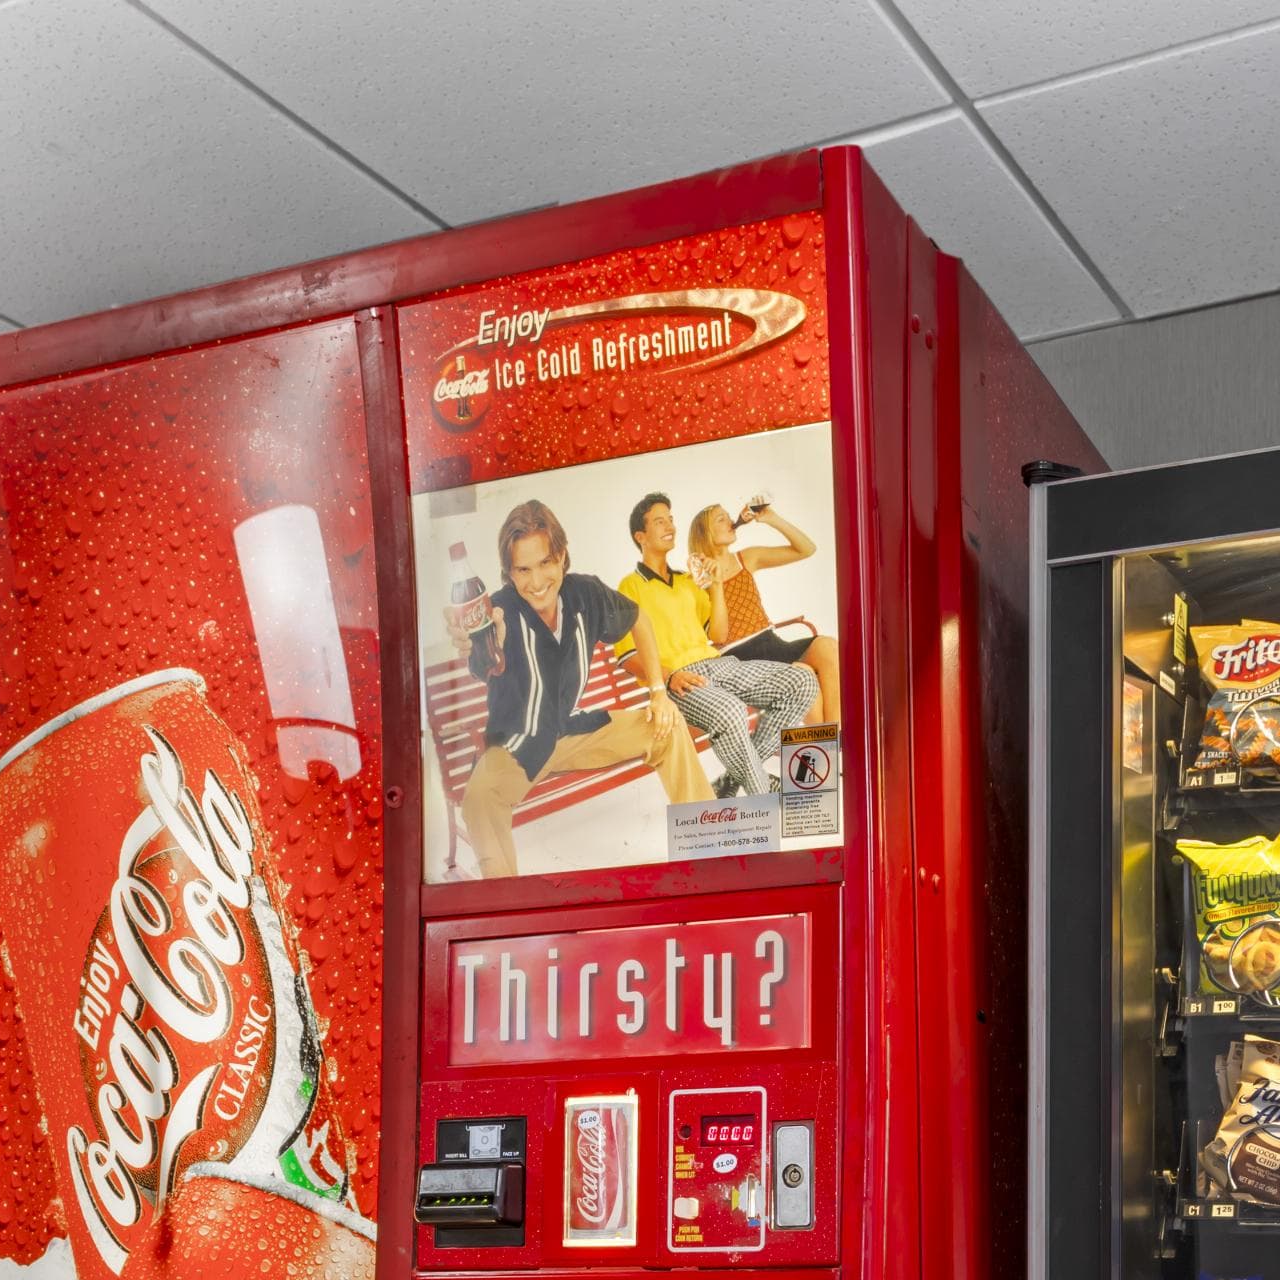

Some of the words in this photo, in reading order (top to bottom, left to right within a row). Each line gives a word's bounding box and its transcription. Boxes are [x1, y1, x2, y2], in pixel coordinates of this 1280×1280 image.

[477, 305, 549, 348] Enjoy
[495, 358, 525, 391] Ice
[537, 343, 580, 381] Cold
[593, 312, 732, 372] Refreshment
[793, 727, 836, 740] WARNING
[675, 816, 698, 827] Local
[740, 810, 770, 821] Bottler
[67, 723, 257, 1278] Coca-Cola
[72, 938, 121, 1053] Enjoy
[458, 930, 784, 1046] Thirsty?
[1190, 1003, 1202, 1013] B1
[215, 995, 273, 1121] CLASSIC
[1259, 1157, 1278, 1169] CHIP
[1188, 1205, 1200, 1216] C1
